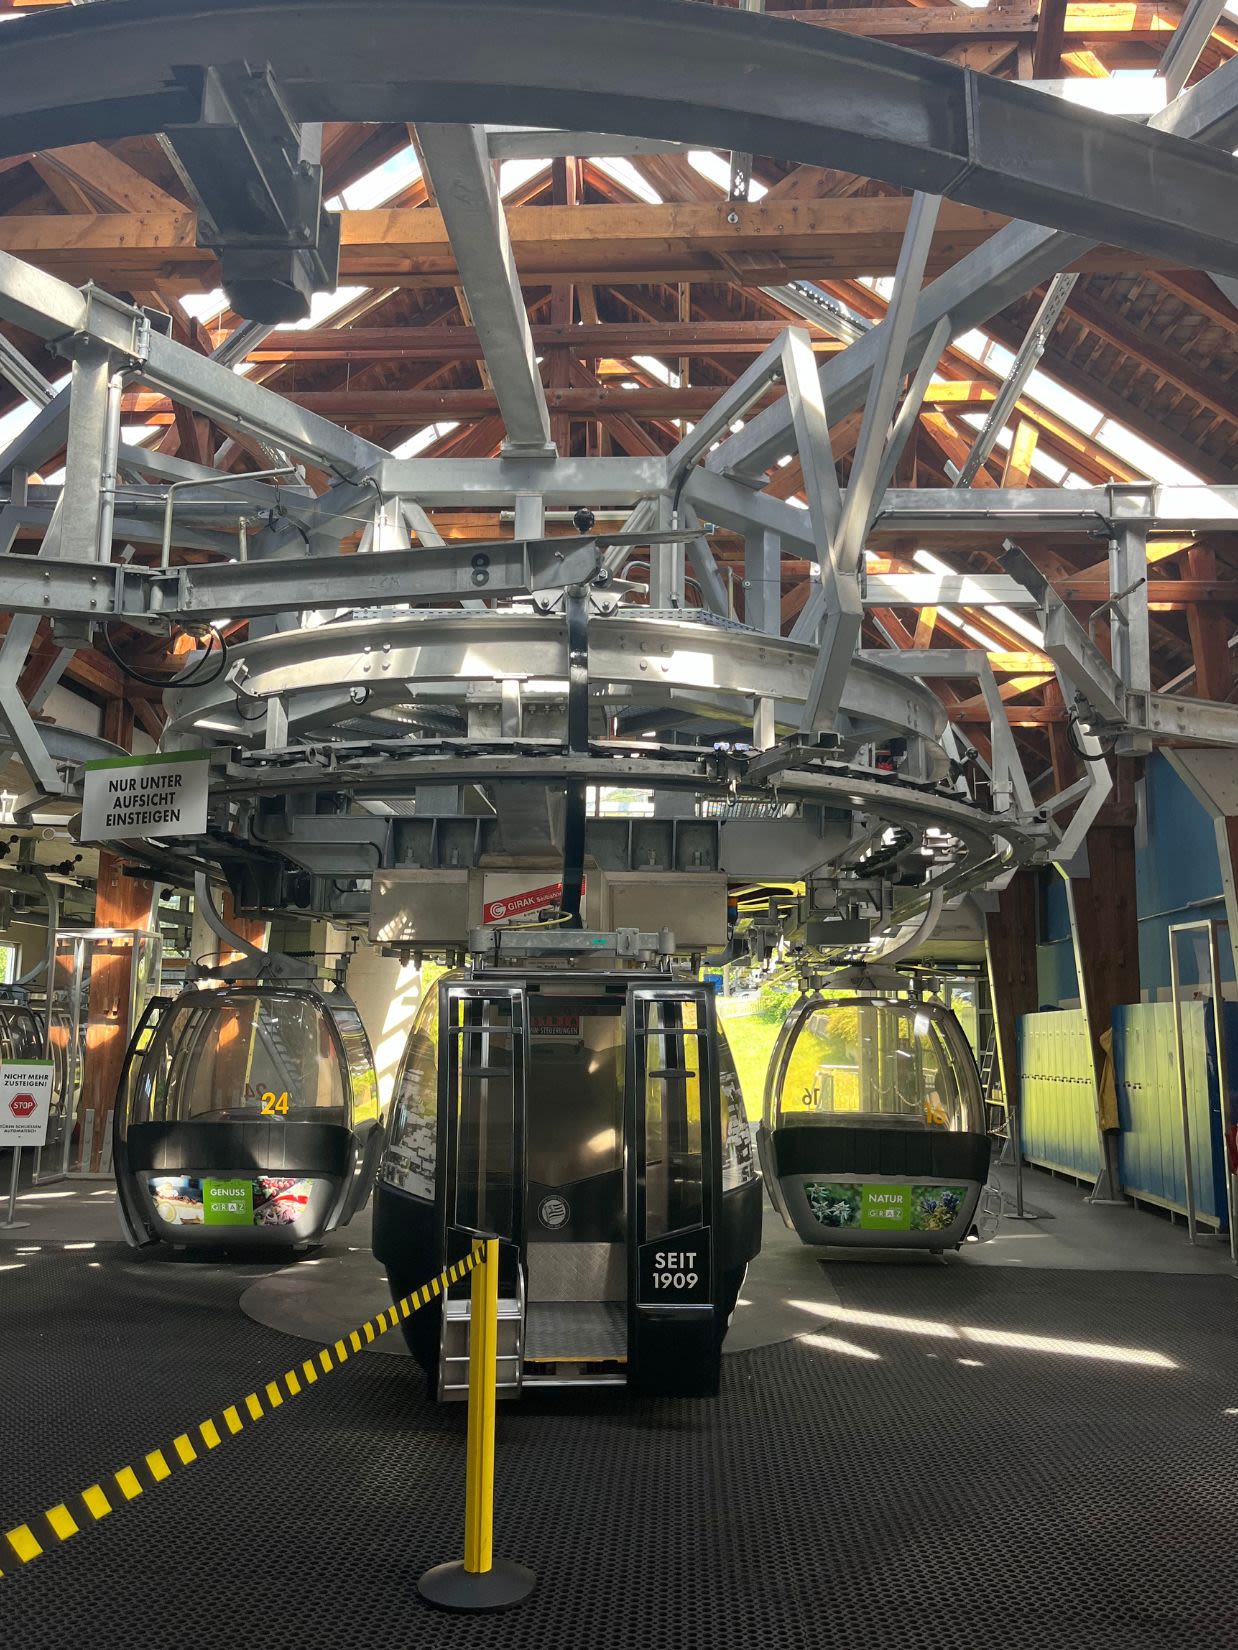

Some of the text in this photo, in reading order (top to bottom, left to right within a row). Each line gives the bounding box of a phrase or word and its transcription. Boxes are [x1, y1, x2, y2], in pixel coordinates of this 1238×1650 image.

[471, 552, 490, 588] 8
[108, 774, 182, 793] NUR UNTER
[112, 791, 176, 810] AUFSICHT
[105, 808, 181, 827] EINSTEIGEN
[507, 896, 535, 911] GIRAK
[13, 1101, 33, 1109] STOP
[260, 1091, 289, 1115] 24
[924, 1102, 947, 1124] 16
[210, 1188, 245, 1197] GENUSS
[868, 1193, 903, 1204] NATUR
[654, 1252, 697, 1269] SEIT
[652, 1272, 699, 1289] 1909
